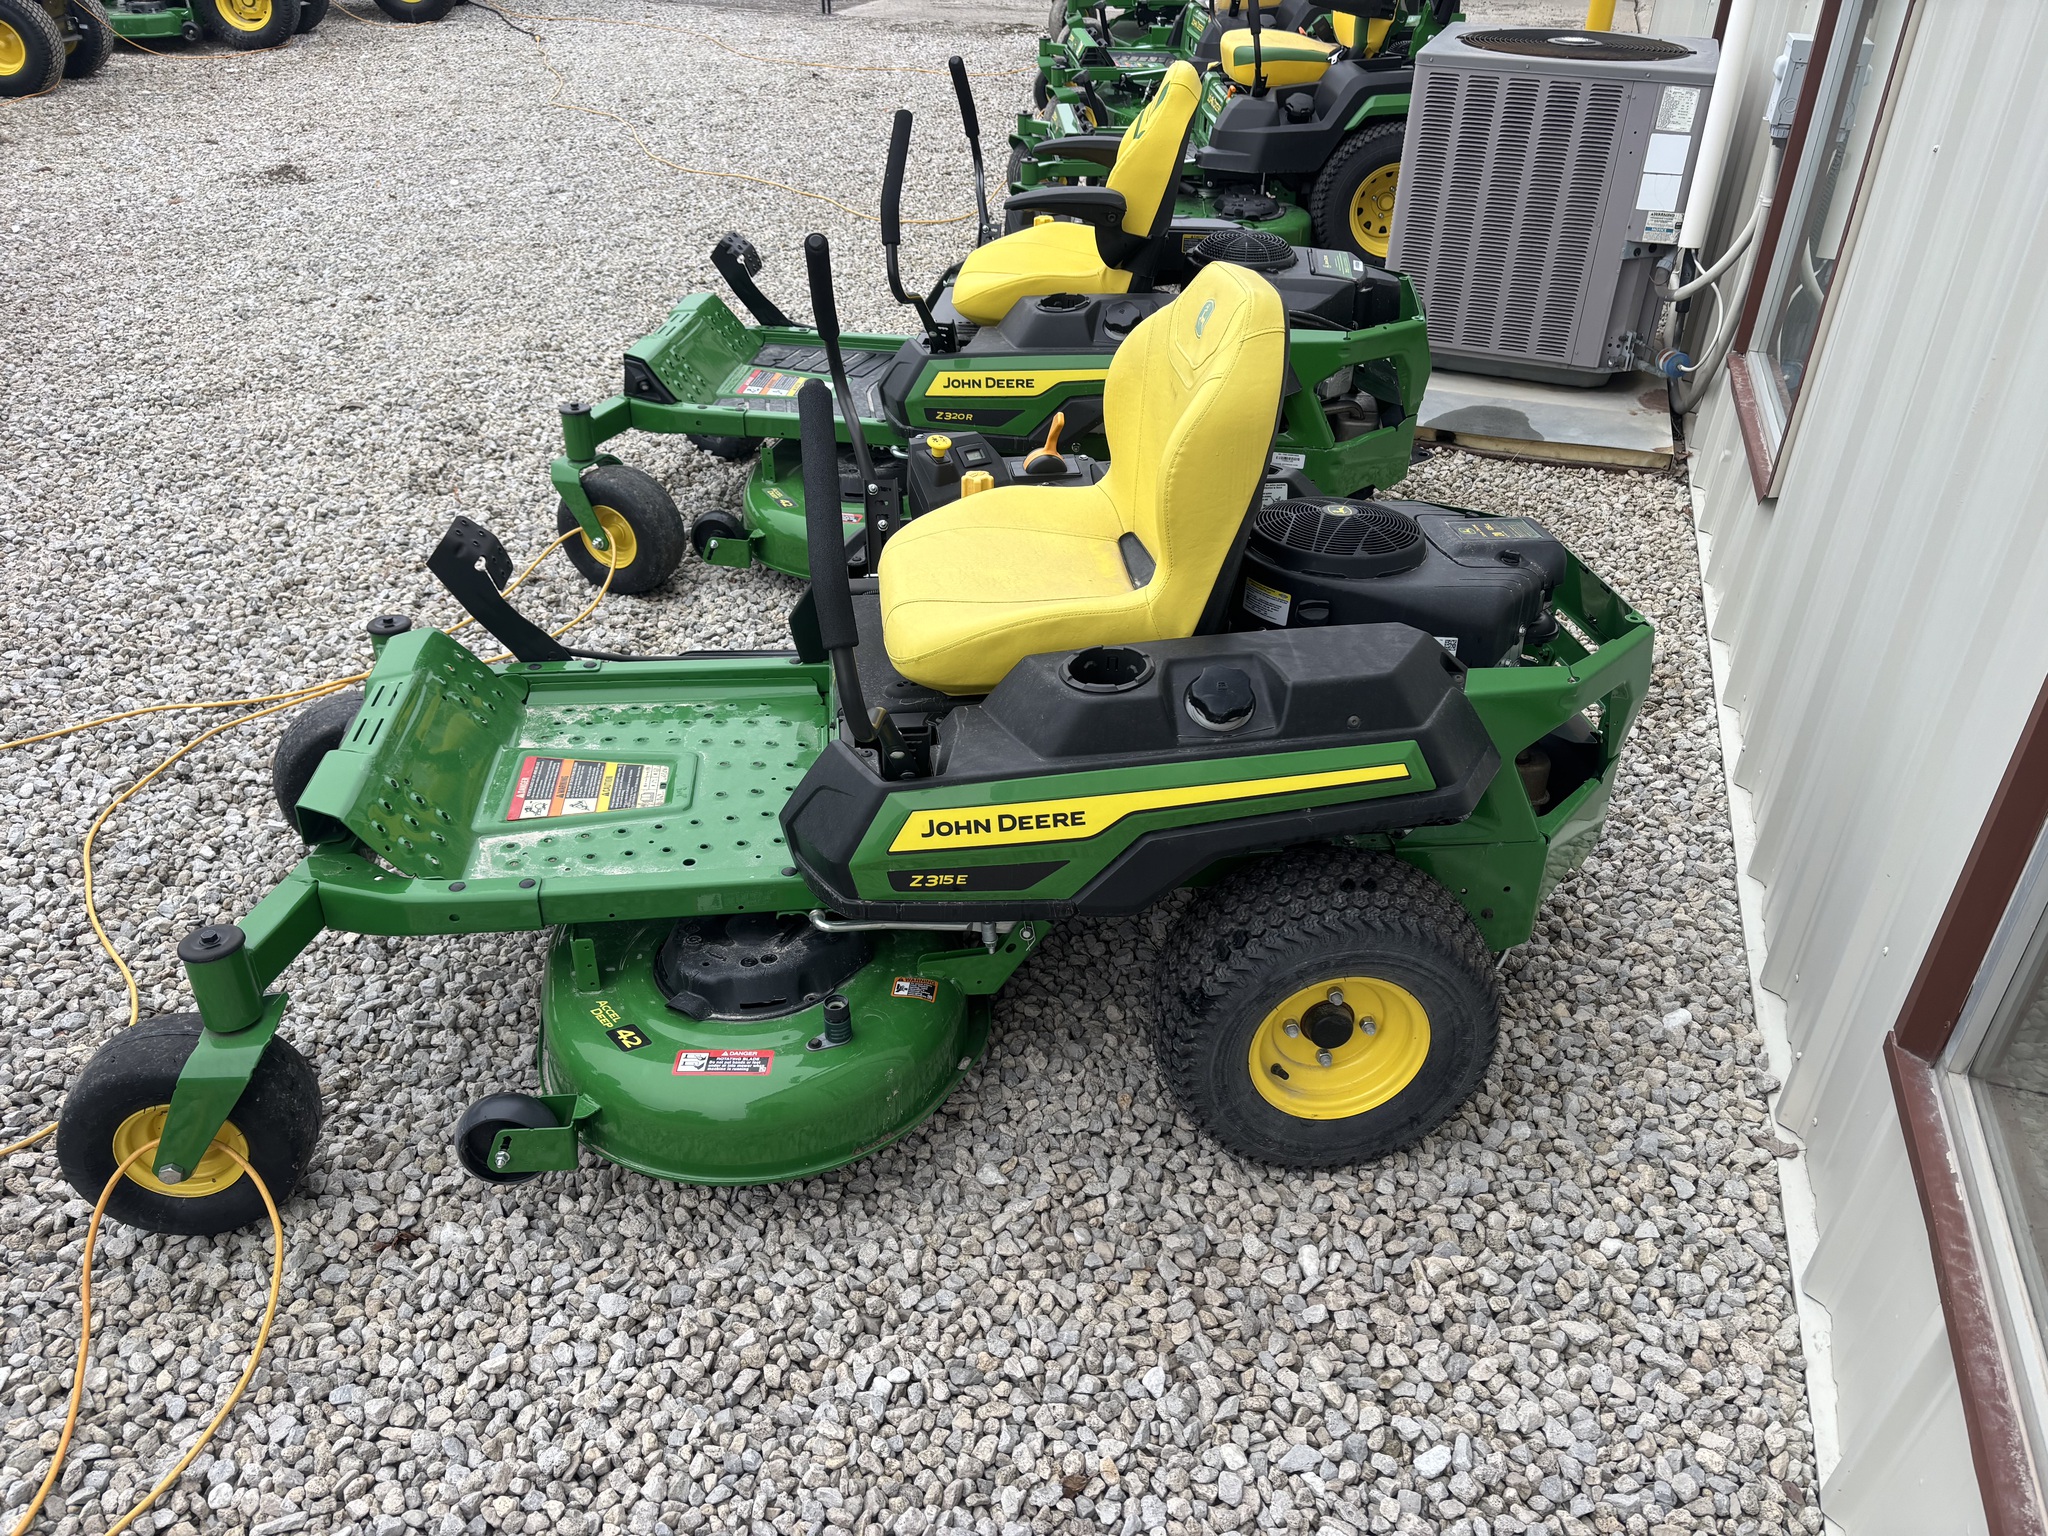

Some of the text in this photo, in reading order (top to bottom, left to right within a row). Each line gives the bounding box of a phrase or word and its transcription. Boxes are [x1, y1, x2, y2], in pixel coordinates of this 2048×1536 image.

[943, 377, 1034, 388] JOHN DEERE
[936, 412, 973, 420] Z320R
[921, 811, 1086, 838] JOHN DEERE
[590, 1008, 614, 1028] DEEP
[596, 1000, 621, 1023] ACCEL
[616, 1029, 643, 1048] 42
